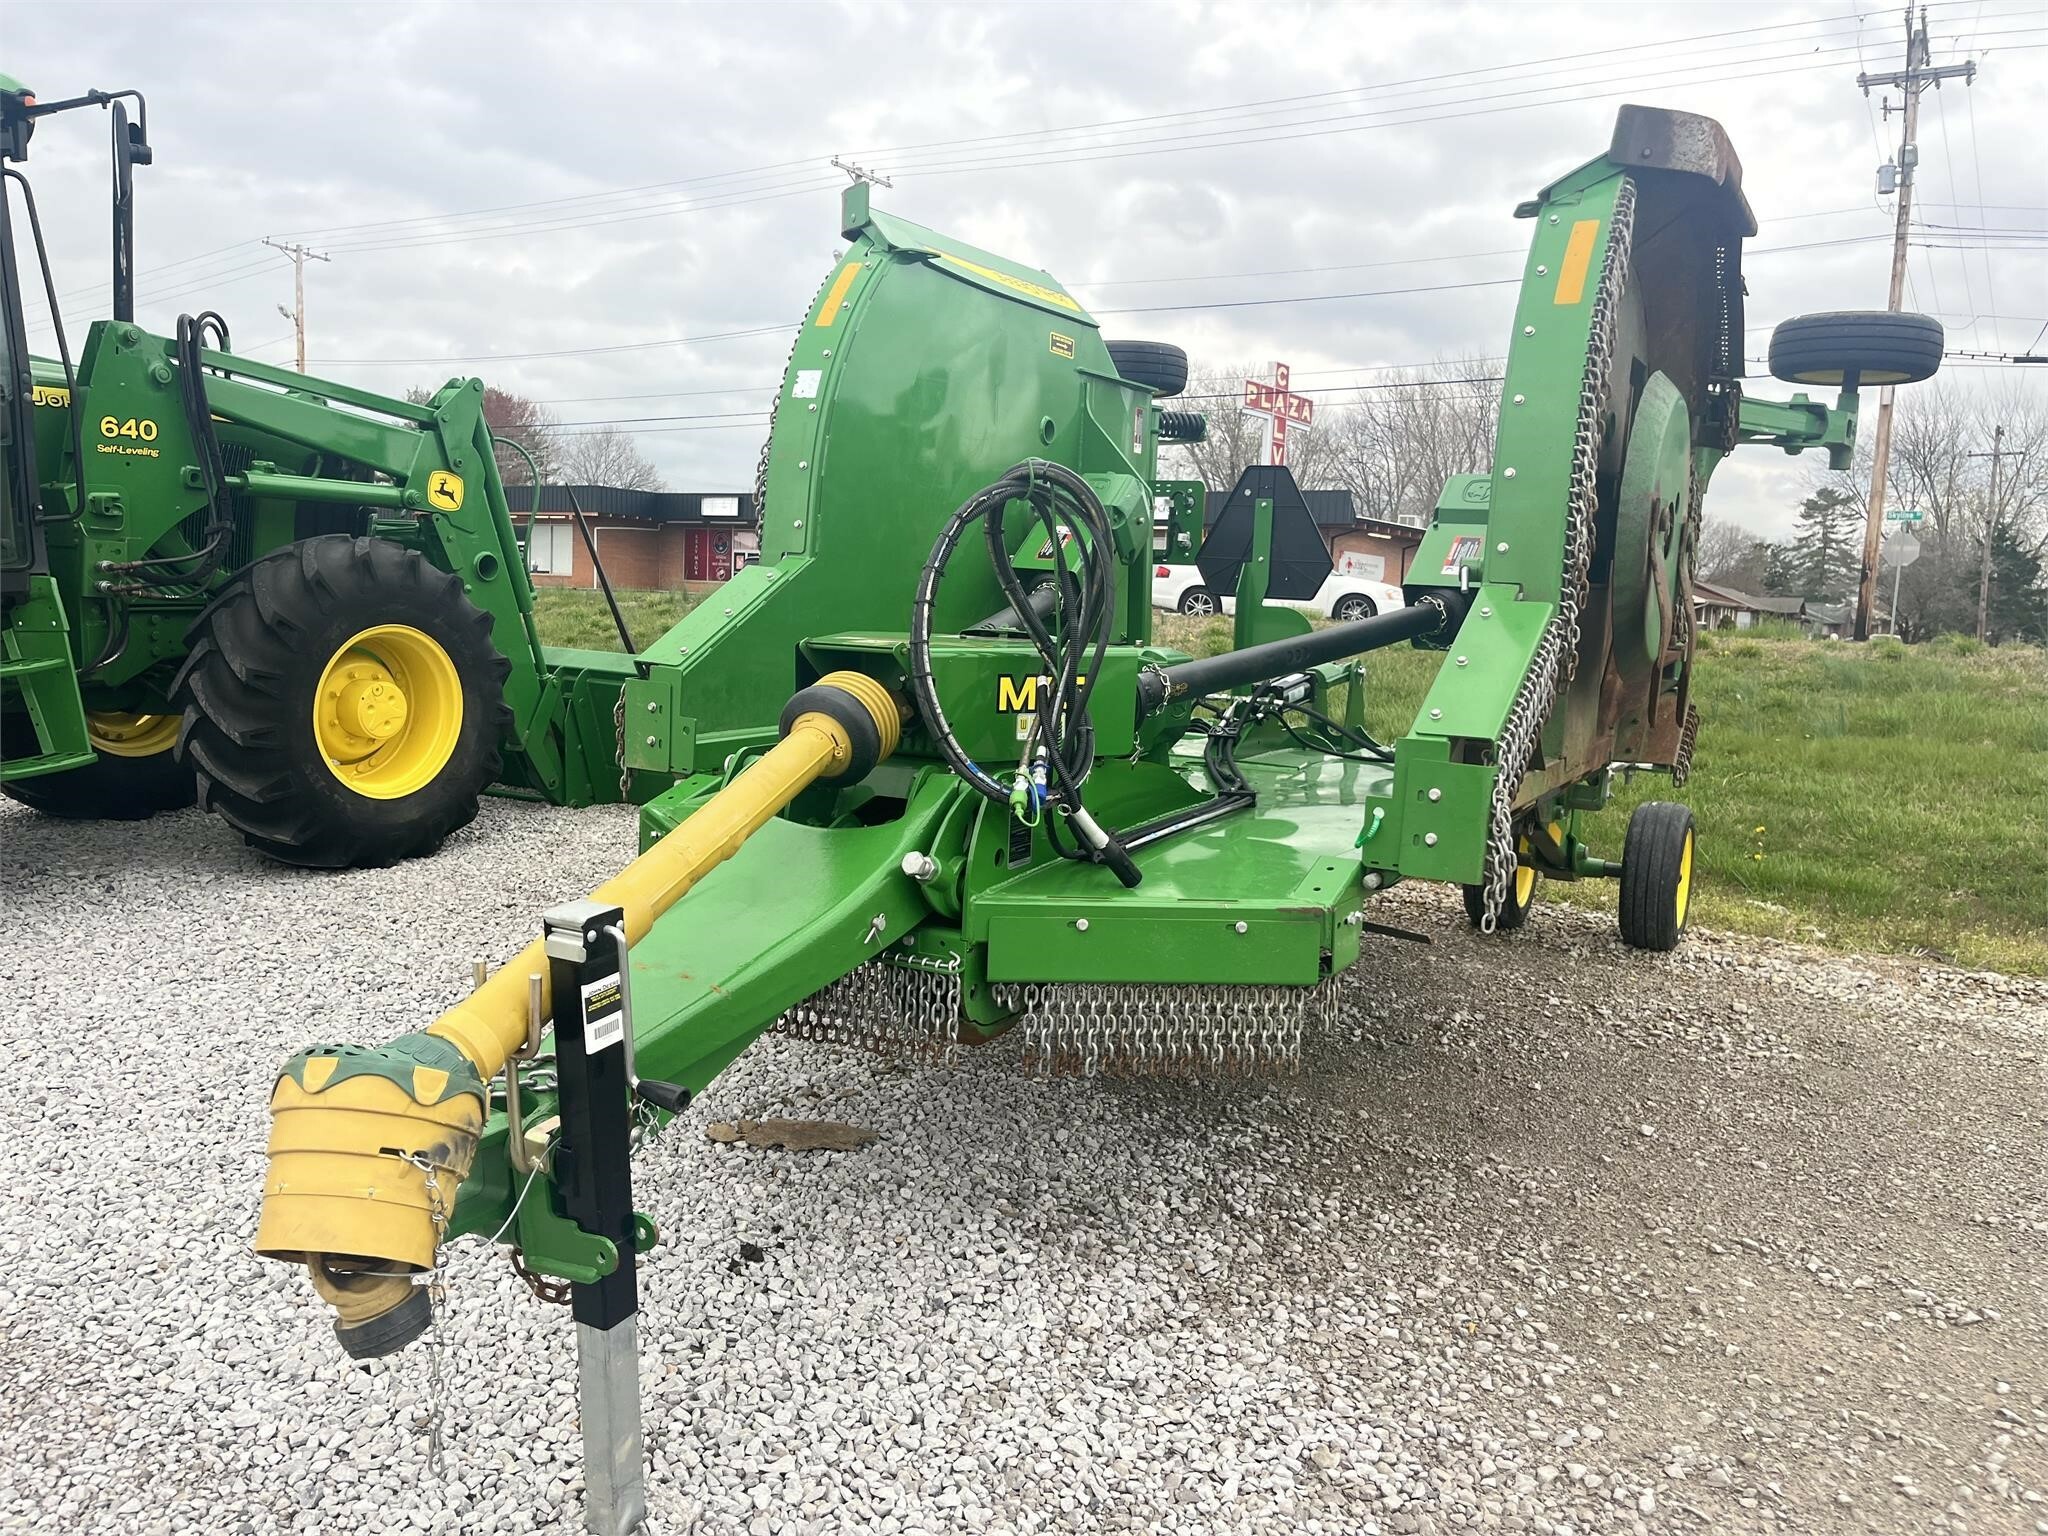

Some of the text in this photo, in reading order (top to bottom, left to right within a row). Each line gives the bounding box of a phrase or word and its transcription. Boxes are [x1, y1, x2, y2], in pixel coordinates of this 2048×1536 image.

[1246, 384, 1311, 422] PLAZA
[100, 416, 158, 441] 640
[97, 444, 160, 457] Self-Leveling
[588, 988, 602, 996] JOHN
